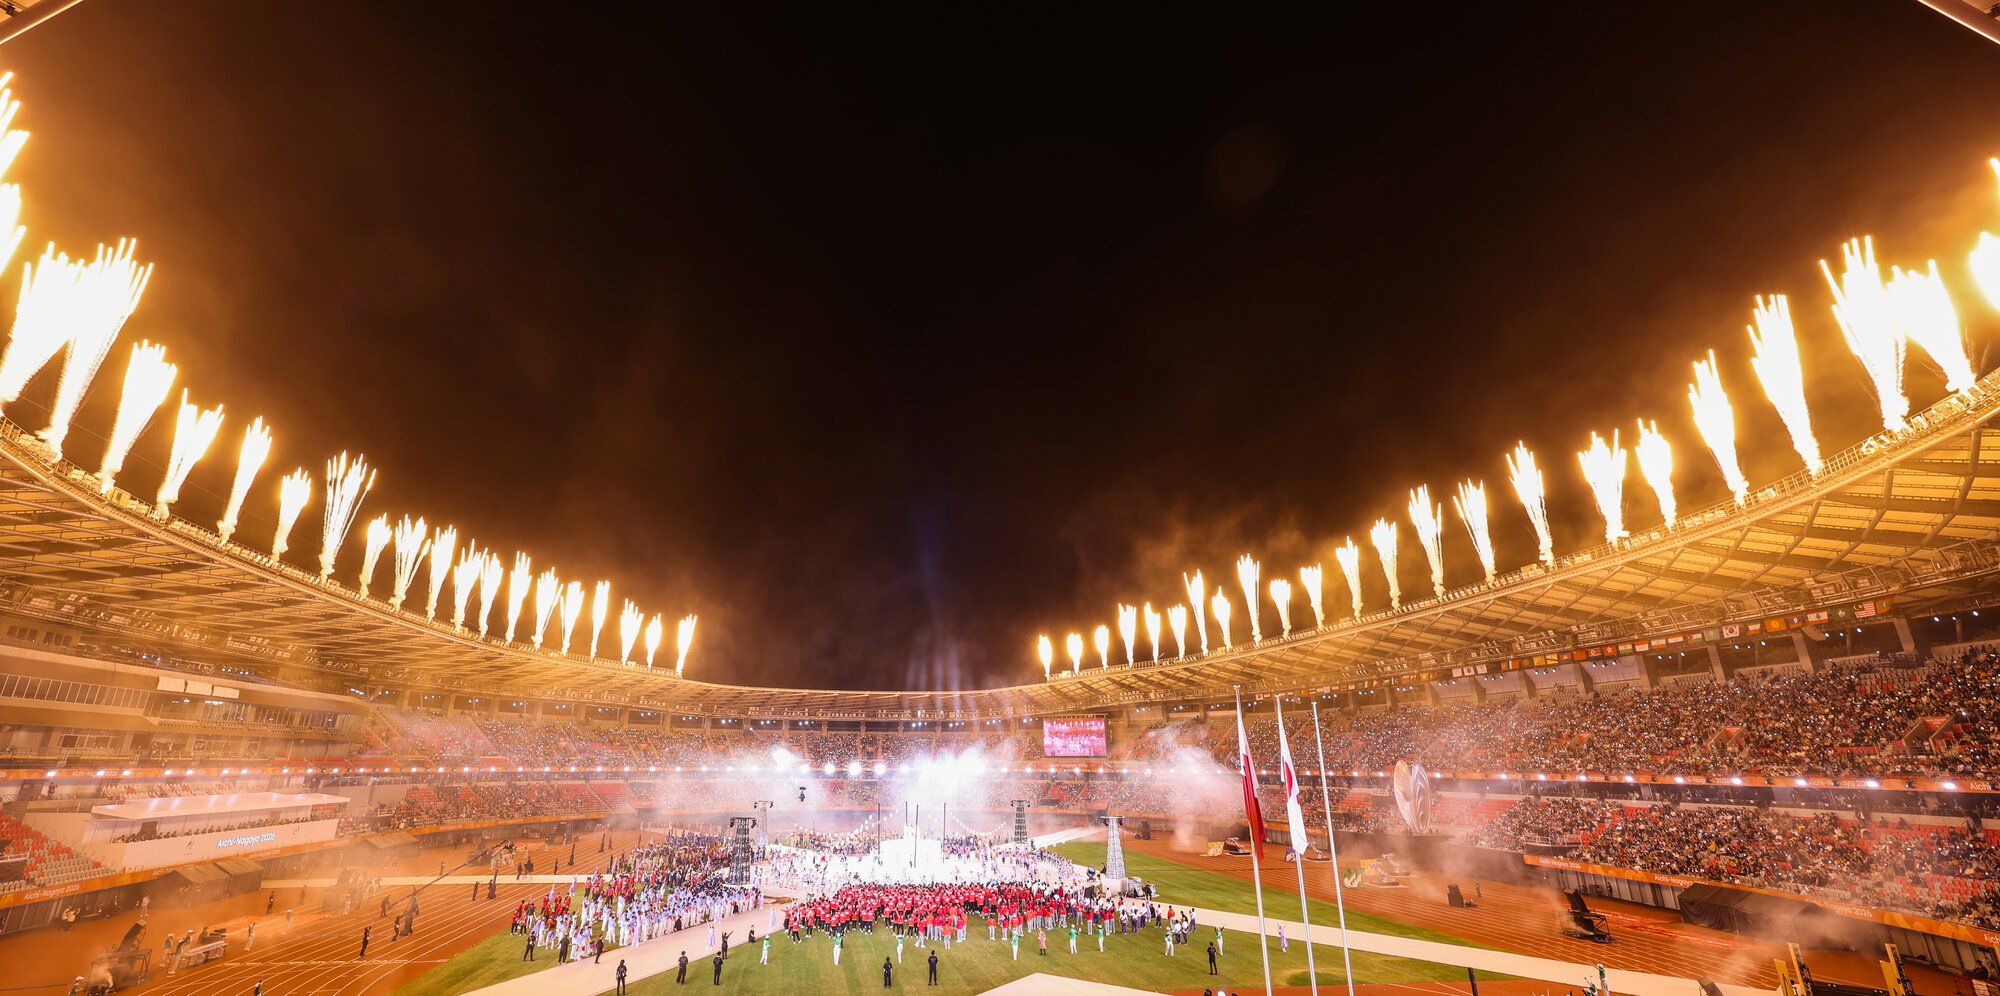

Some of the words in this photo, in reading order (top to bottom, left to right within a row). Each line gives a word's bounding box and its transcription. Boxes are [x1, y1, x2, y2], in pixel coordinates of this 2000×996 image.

[1970, 782, 1991, 790] Aichi
[216, 836, 260, 848] Aichi-Nagoya
[260, 832, 276, 842] 2026
[1569, 861, 1581, 869] 2026
[1654, 874, 1694, 888] Aichi-Nagoya
[24, 887, 65, 900] Aichi-Nagoya
[65, 884, 80, 893] 2026
[1805, 897, 1853, 914] hi-Nagoya
[1853, 907, 1873, 918] 2026
[1984, 933, 2000, 945] Aich
